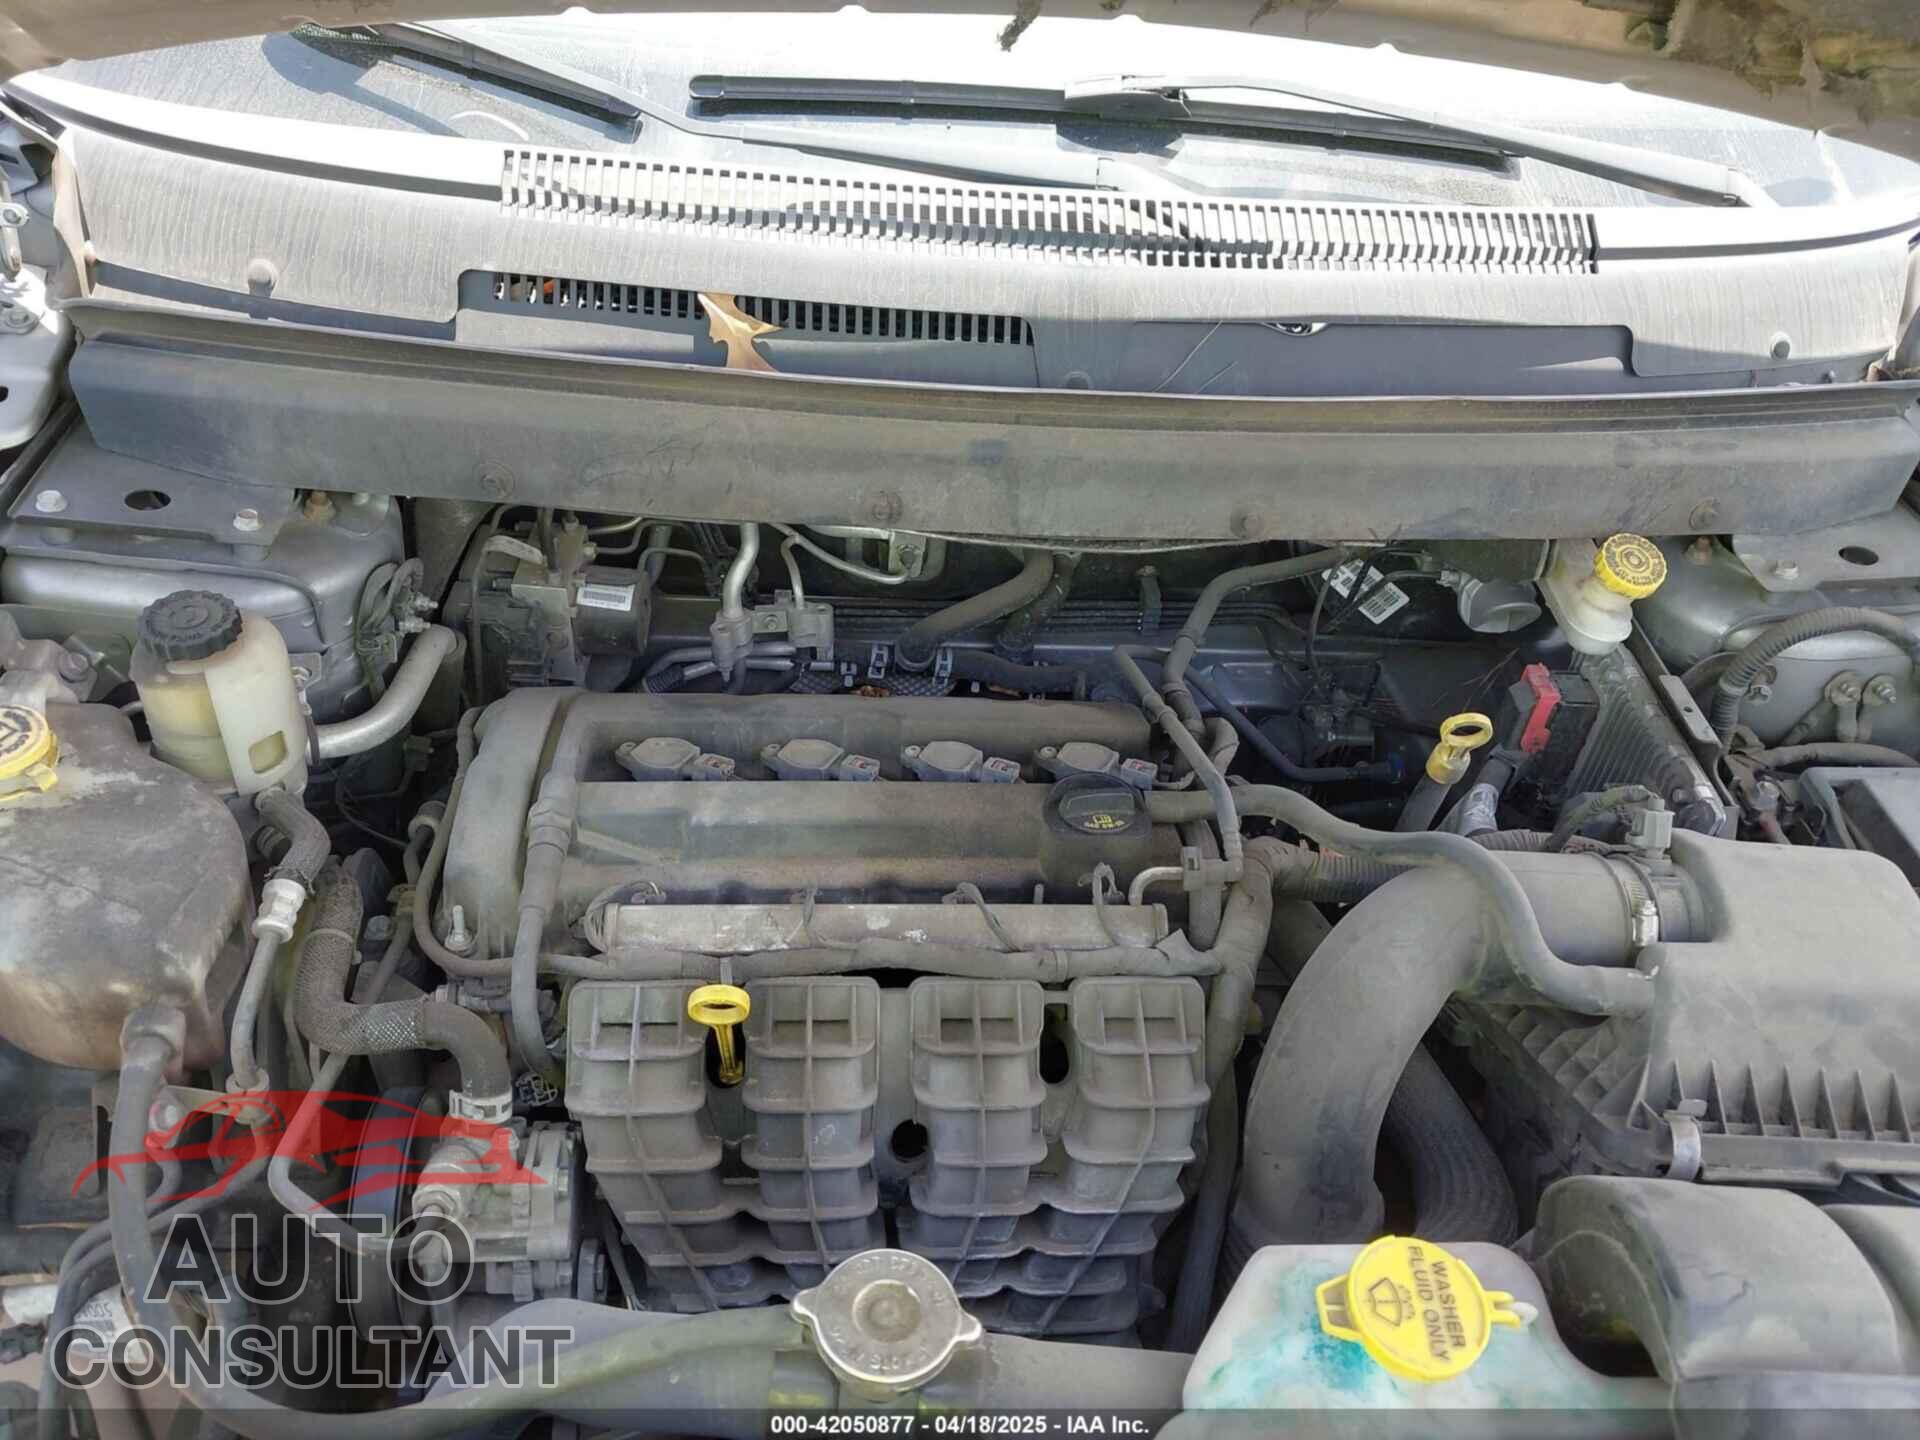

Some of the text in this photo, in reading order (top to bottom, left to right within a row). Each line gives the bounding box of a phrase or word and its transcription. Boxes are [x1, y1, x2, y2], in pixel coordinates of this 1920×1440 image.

[1407, 1245, 1450, 1361] FLUID ONLY
[1431, 1260, 1466, 1347] WASHER
